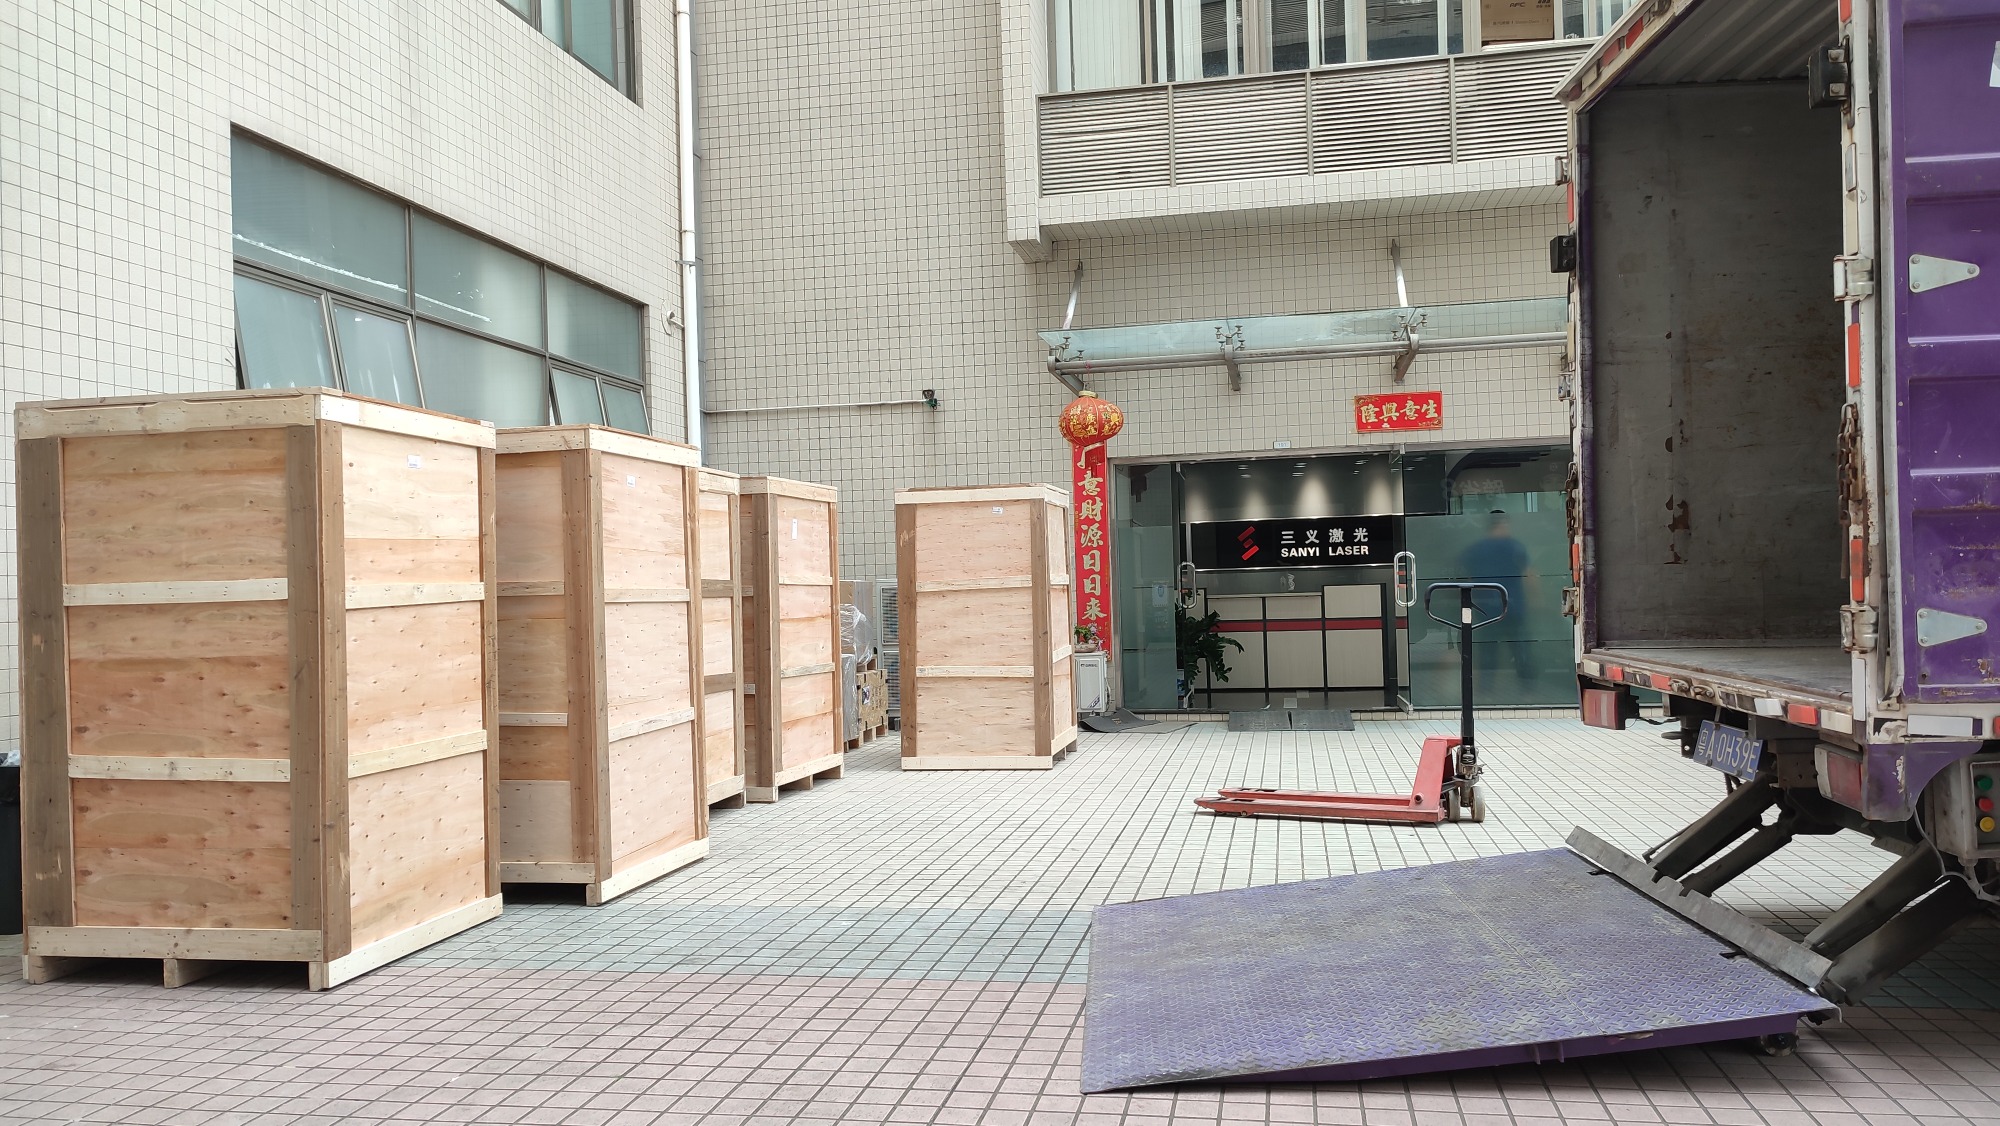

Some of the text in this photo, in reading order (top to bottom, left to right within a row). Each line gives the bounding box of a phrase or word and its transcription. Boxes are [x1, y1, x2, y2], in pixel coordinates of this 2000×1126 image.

[1280, 527, 1369, 545] 三义激光
[1280, 545, 1369, 558] SANYI LASER
